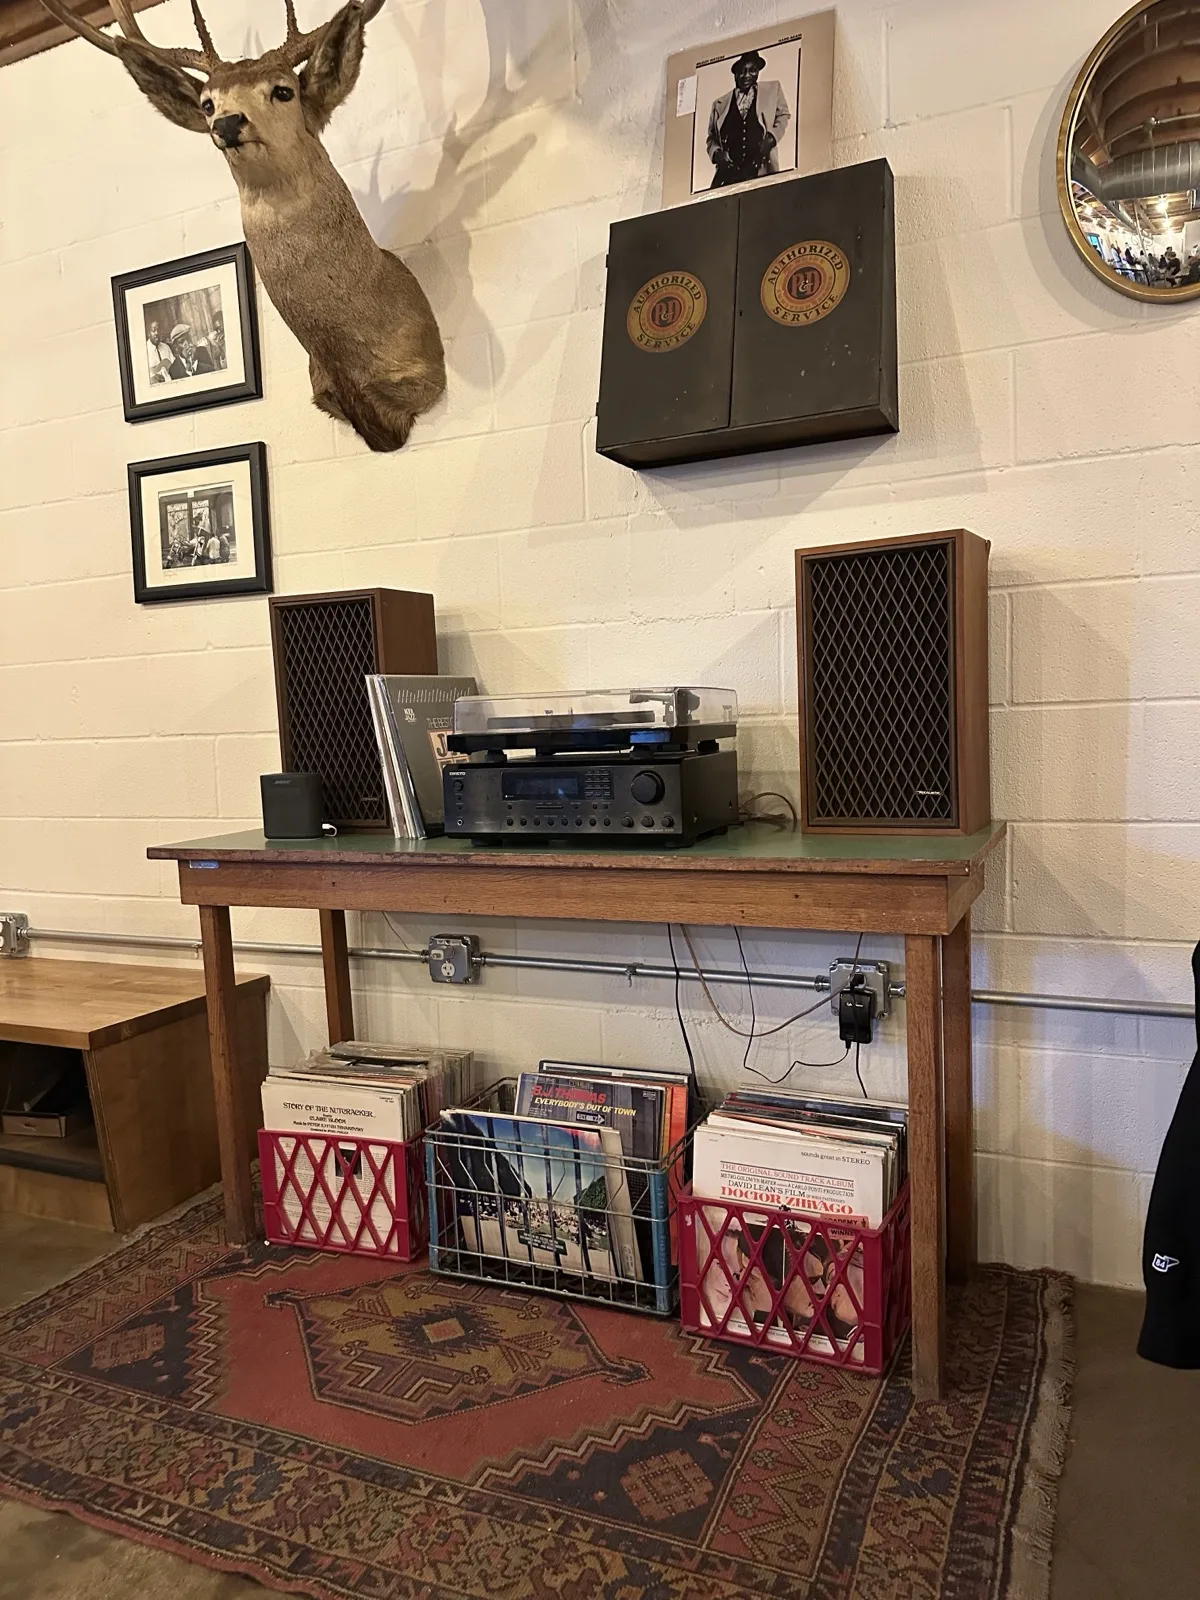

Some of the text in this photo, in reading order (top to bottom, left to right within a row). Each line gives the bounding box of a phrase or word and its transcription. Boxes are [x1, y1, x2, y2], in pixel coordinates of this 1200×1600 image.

[768, 245, 844, 285] AUTHORIZED
[633, 275, 702, 313] AUTHORIZED
[773, 294, 838, 322] SERVICE
[637, 322, 696, 348] SERVICE
[283, 1102, 304, 1111] STORY
[534, 1097, 636, 1116] EVERYBODY'S OUT OF TOWN
[801, 1151, 820, 1159] sounds
[841, 1156, 870, 1166] STEREO
[721, 1163, 854, 1188] THE ORIGINAL SOUND TRACK ALBUM
[721, 1186, 782, 1205] DOCTOR
[728, 1180, 753, 1189] DAVID
[753, 1184, 784, 1195] LEAN'S
[784, 1188, 806, 1198] FILM
